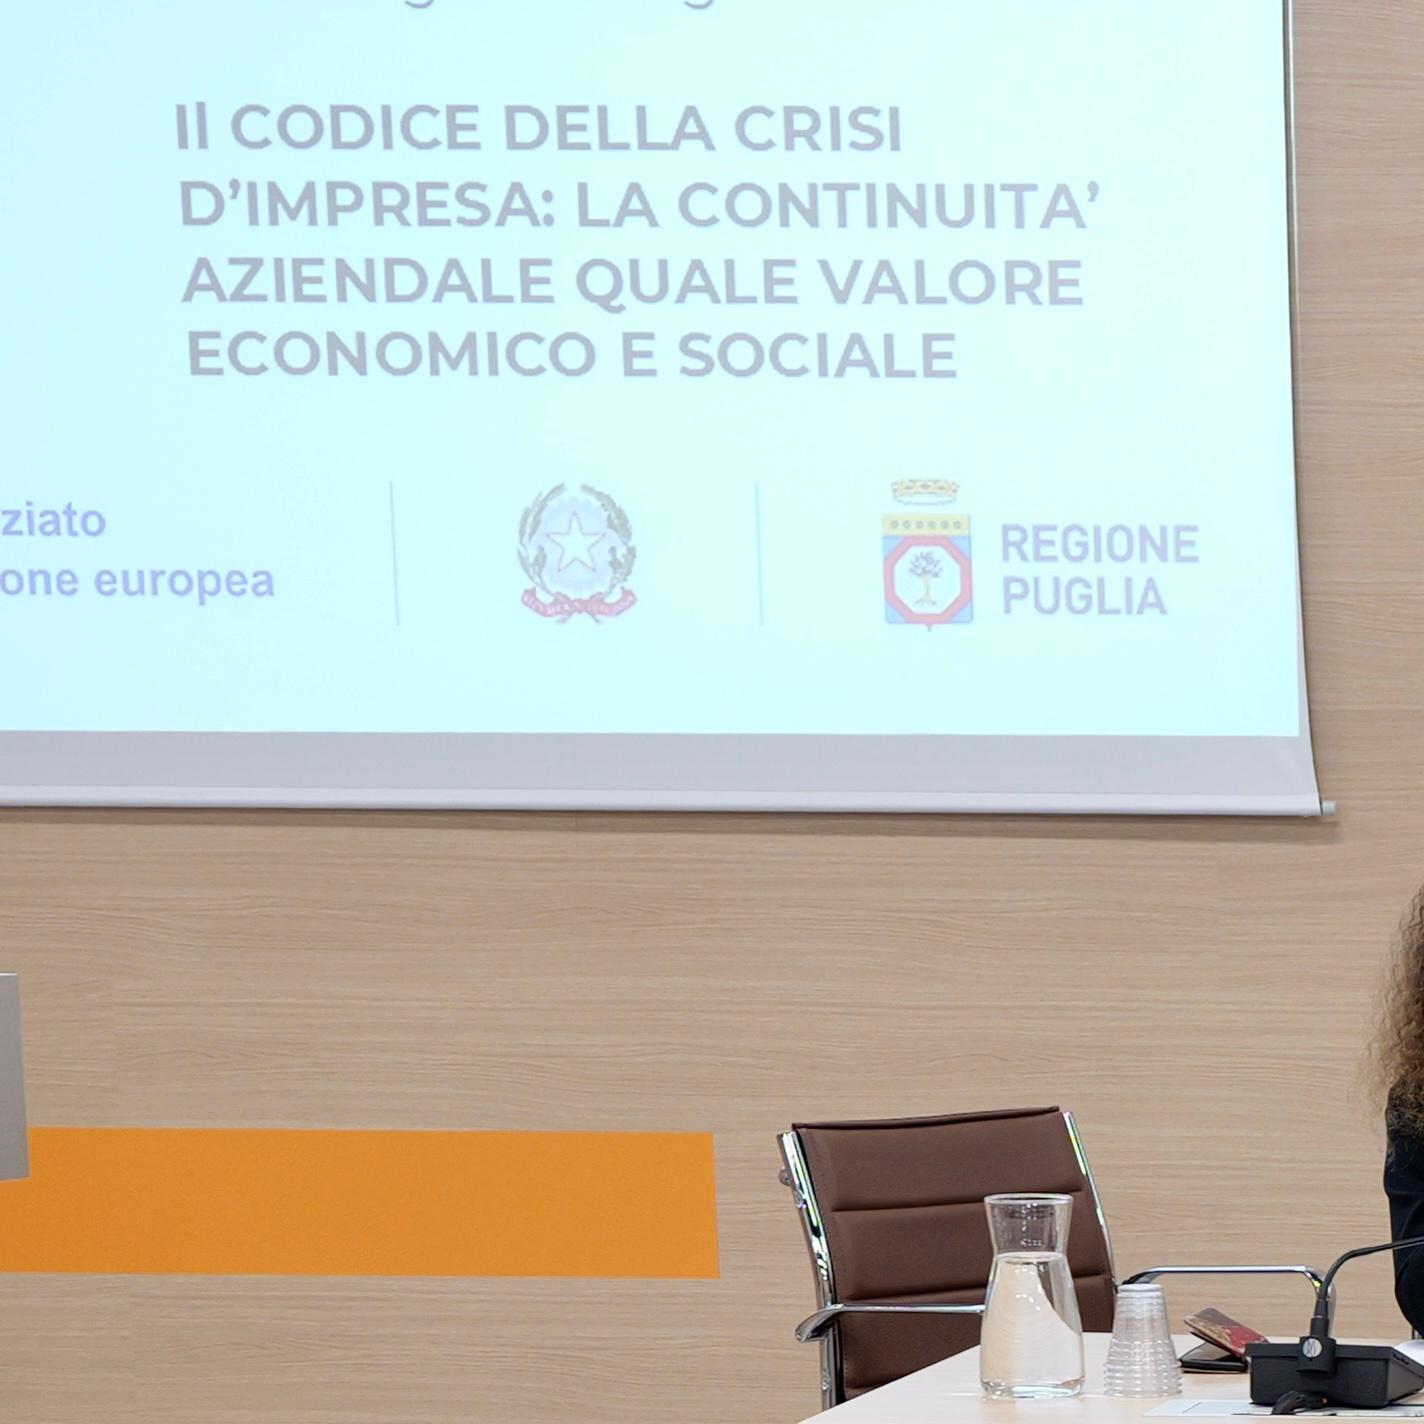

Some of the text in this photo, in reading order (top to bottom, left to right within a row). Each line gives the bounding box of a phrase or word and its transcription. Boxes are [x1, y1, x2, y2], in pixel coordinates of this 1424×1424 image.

[175, 101, 902, 153] Il CODICE DELLA CRISI
[179, 177, 1100, 230] D'IMPRESA: LA CONTINUITA'
[180, 256, 1084, 315] AZIENDALE QUALE VALORE
[187, 330, 958, 379] ECONOMICO E SOCIALE
[1000, 523, 1200, 564] REGIONE
[93, 569, 275, 607] europea
[1002, 575, 1169, 617] PUGLIA
